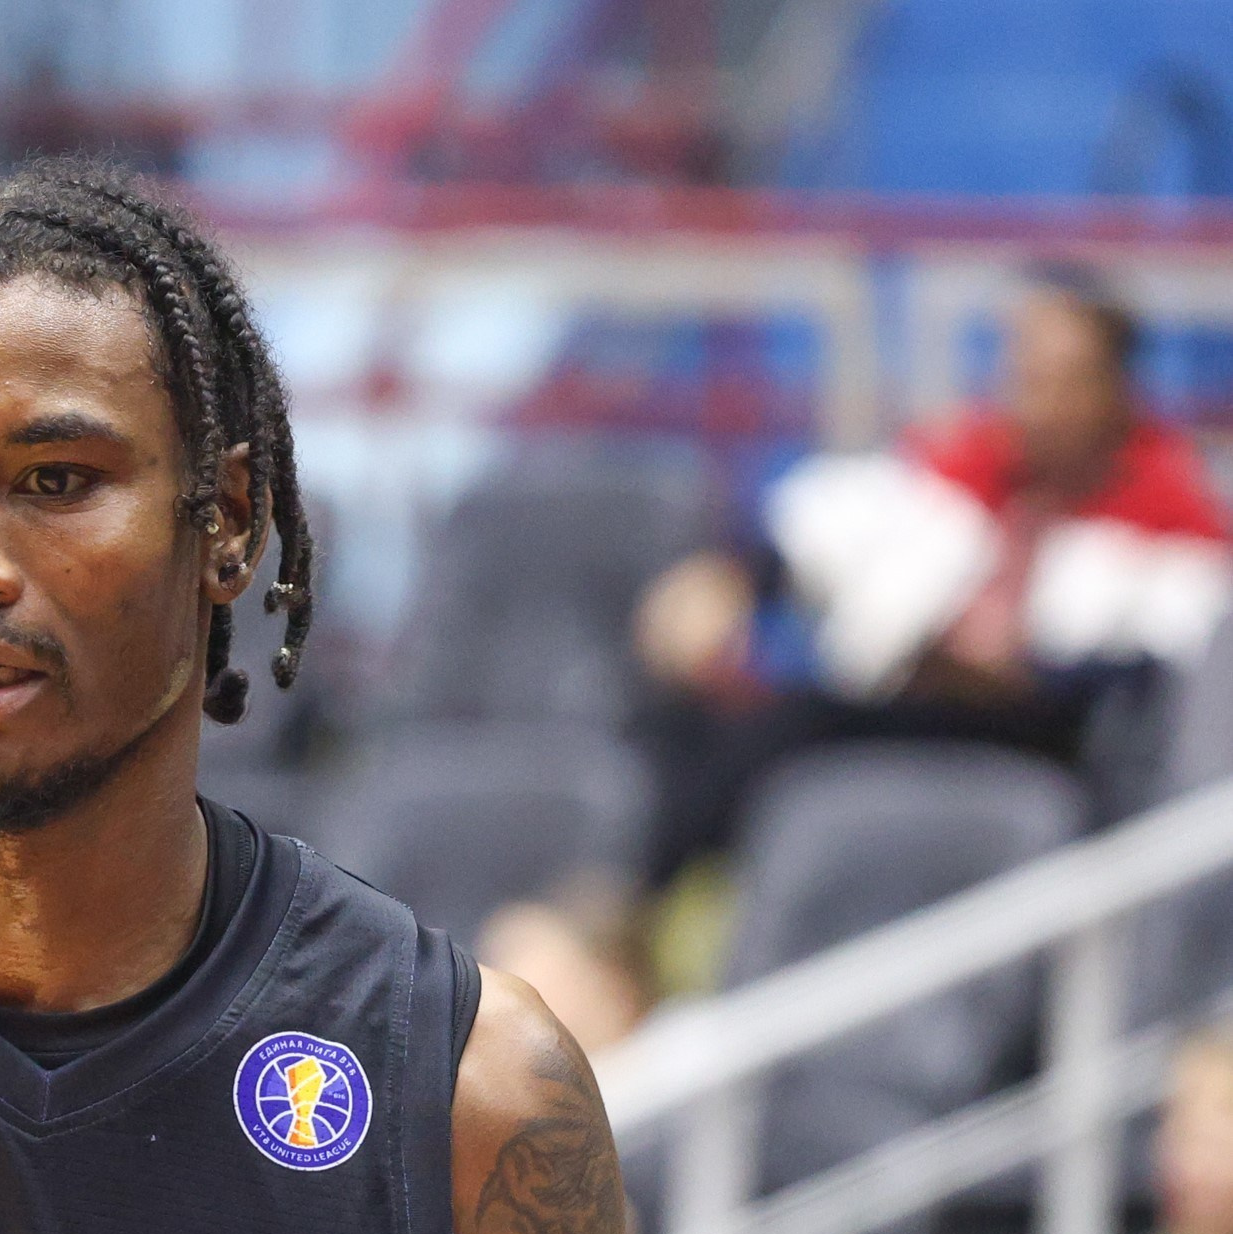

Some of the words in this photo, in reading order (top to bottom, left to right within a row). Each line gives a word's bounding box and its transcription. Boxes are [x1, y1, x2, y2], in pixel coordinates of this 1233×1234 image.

[258, 1039, 303, 1061] ЕДИНАЯ
[306, 1041, 338, 1060] ЛИГА
[252, 1124, 270, 1144] VTB
[270, 1141, 312, 1162] UNITED
[313, 1137, 352, 1162] LEAGUE
